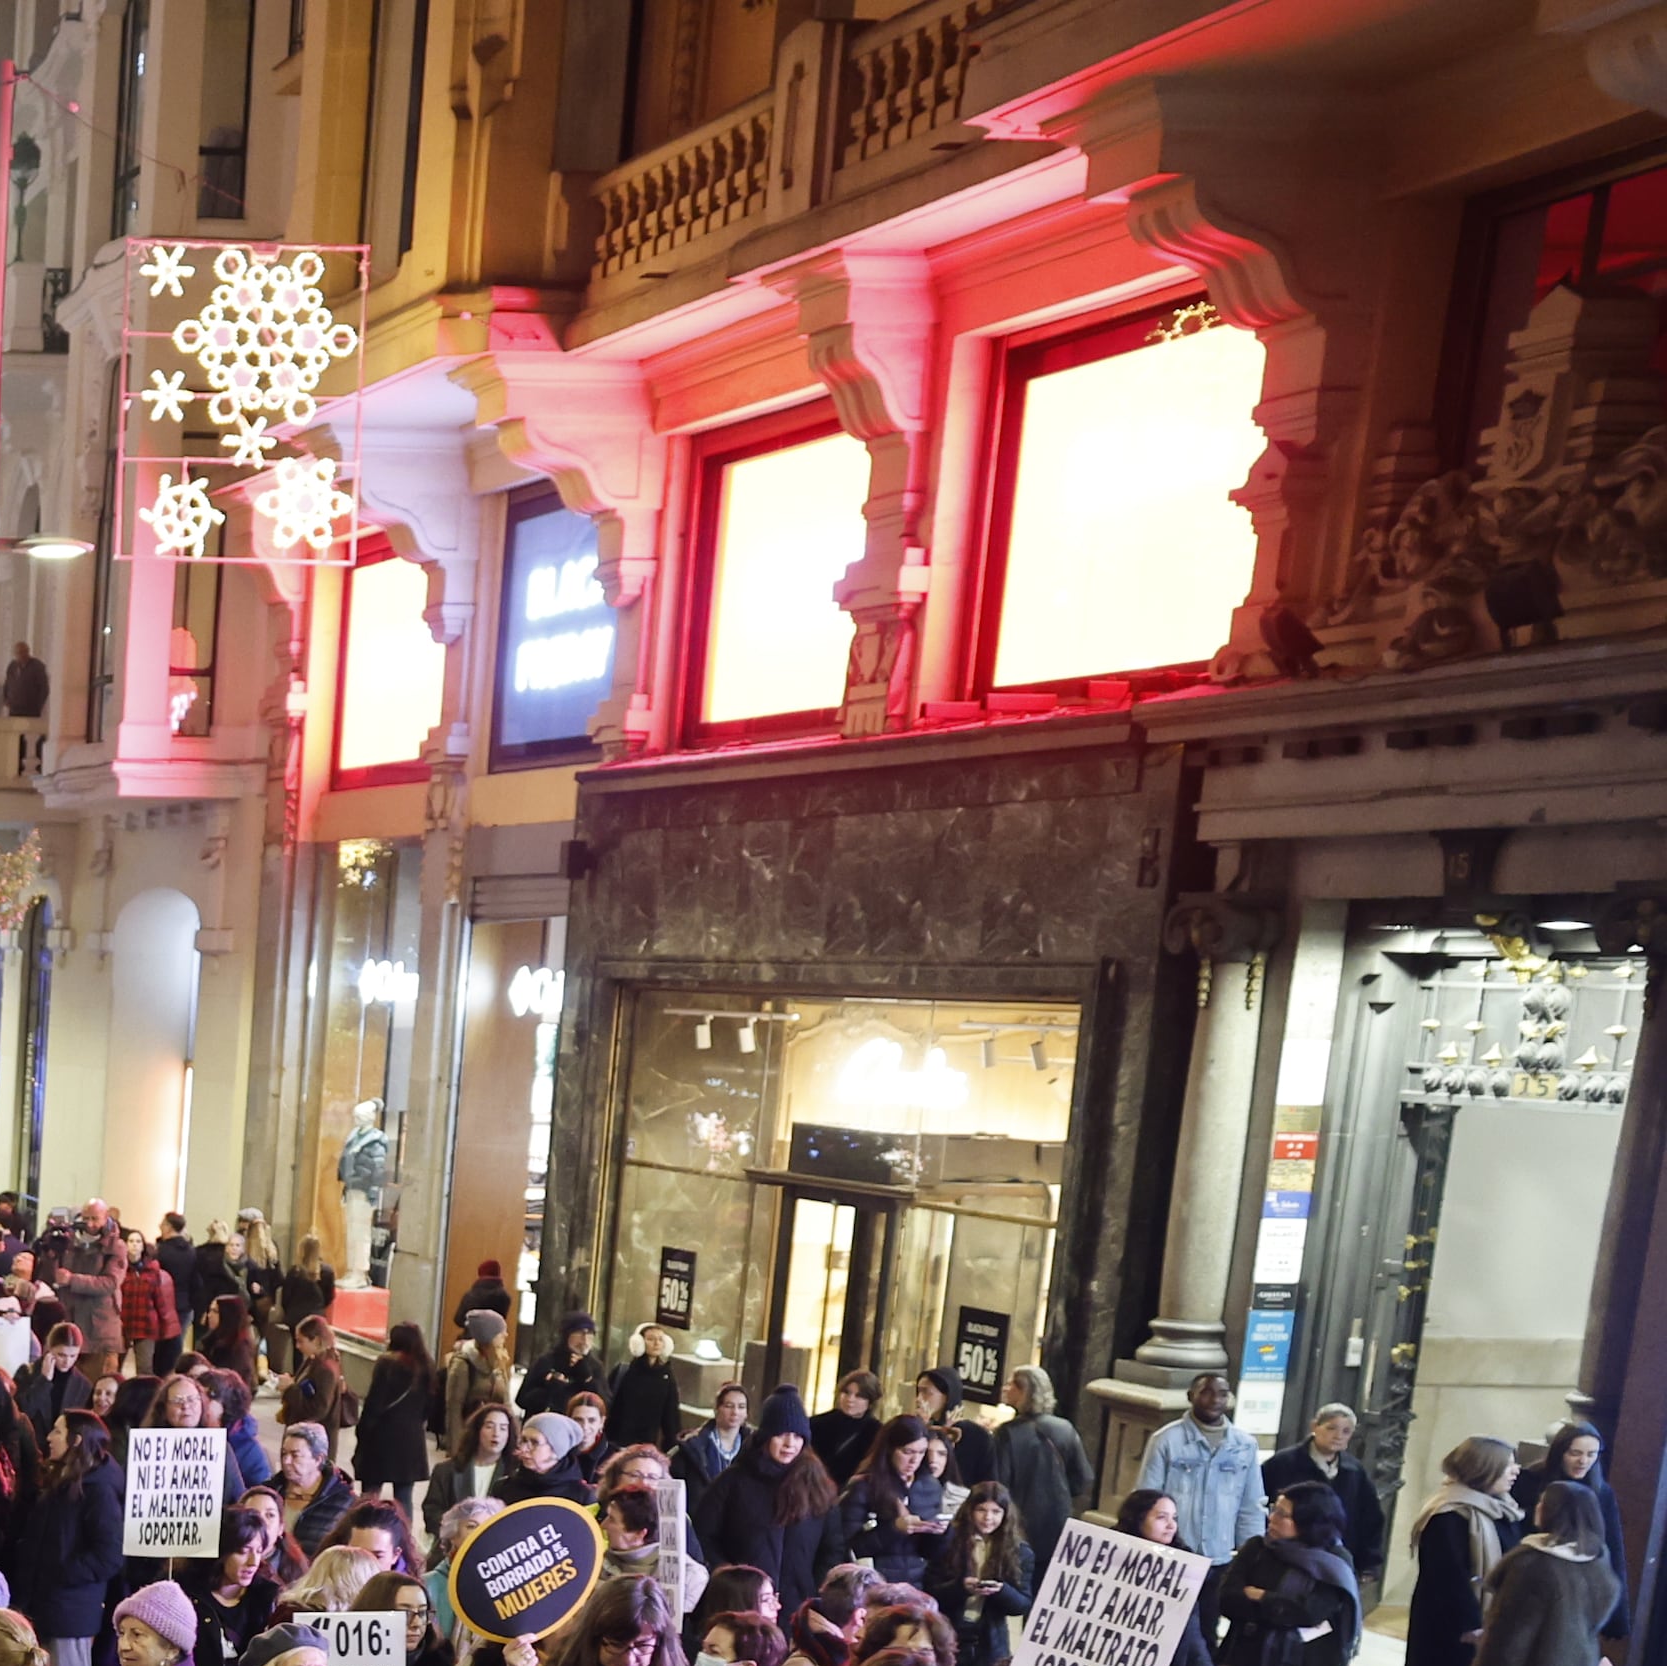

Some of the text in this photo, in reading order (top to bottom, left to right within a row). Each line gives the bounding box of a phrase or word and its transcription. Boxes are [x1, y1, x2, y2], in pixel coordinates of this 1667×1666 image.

[1519, 1076, 1550, 1097] 15
[982, 1371, 997, 1386] OFF
[132, 1436, 219, 1463] NO ES MORAL,
[136, 1465, 212, 1491] NI ES AMAR,
[131, 1492, 214, 1518] EL MALTRATO
[138, 1522, 203, 1547] SOPORTAR.
[476, 1523, 563, 1580] CONTRA EL
[555, 1547, 570, 1561] LAS
[1057, 1530, 1190, 1603] NO ES MORAL,
[484, 1541, 563, 1599] BORRADO DE
[493, 1558, 578, 1621] MUJERES
[1048, 1570, 1166, 1640] NI ES AMAR,
[335, 1621, 392, 1657] 016:
[1028, 1607, 1050, 1646] EL
